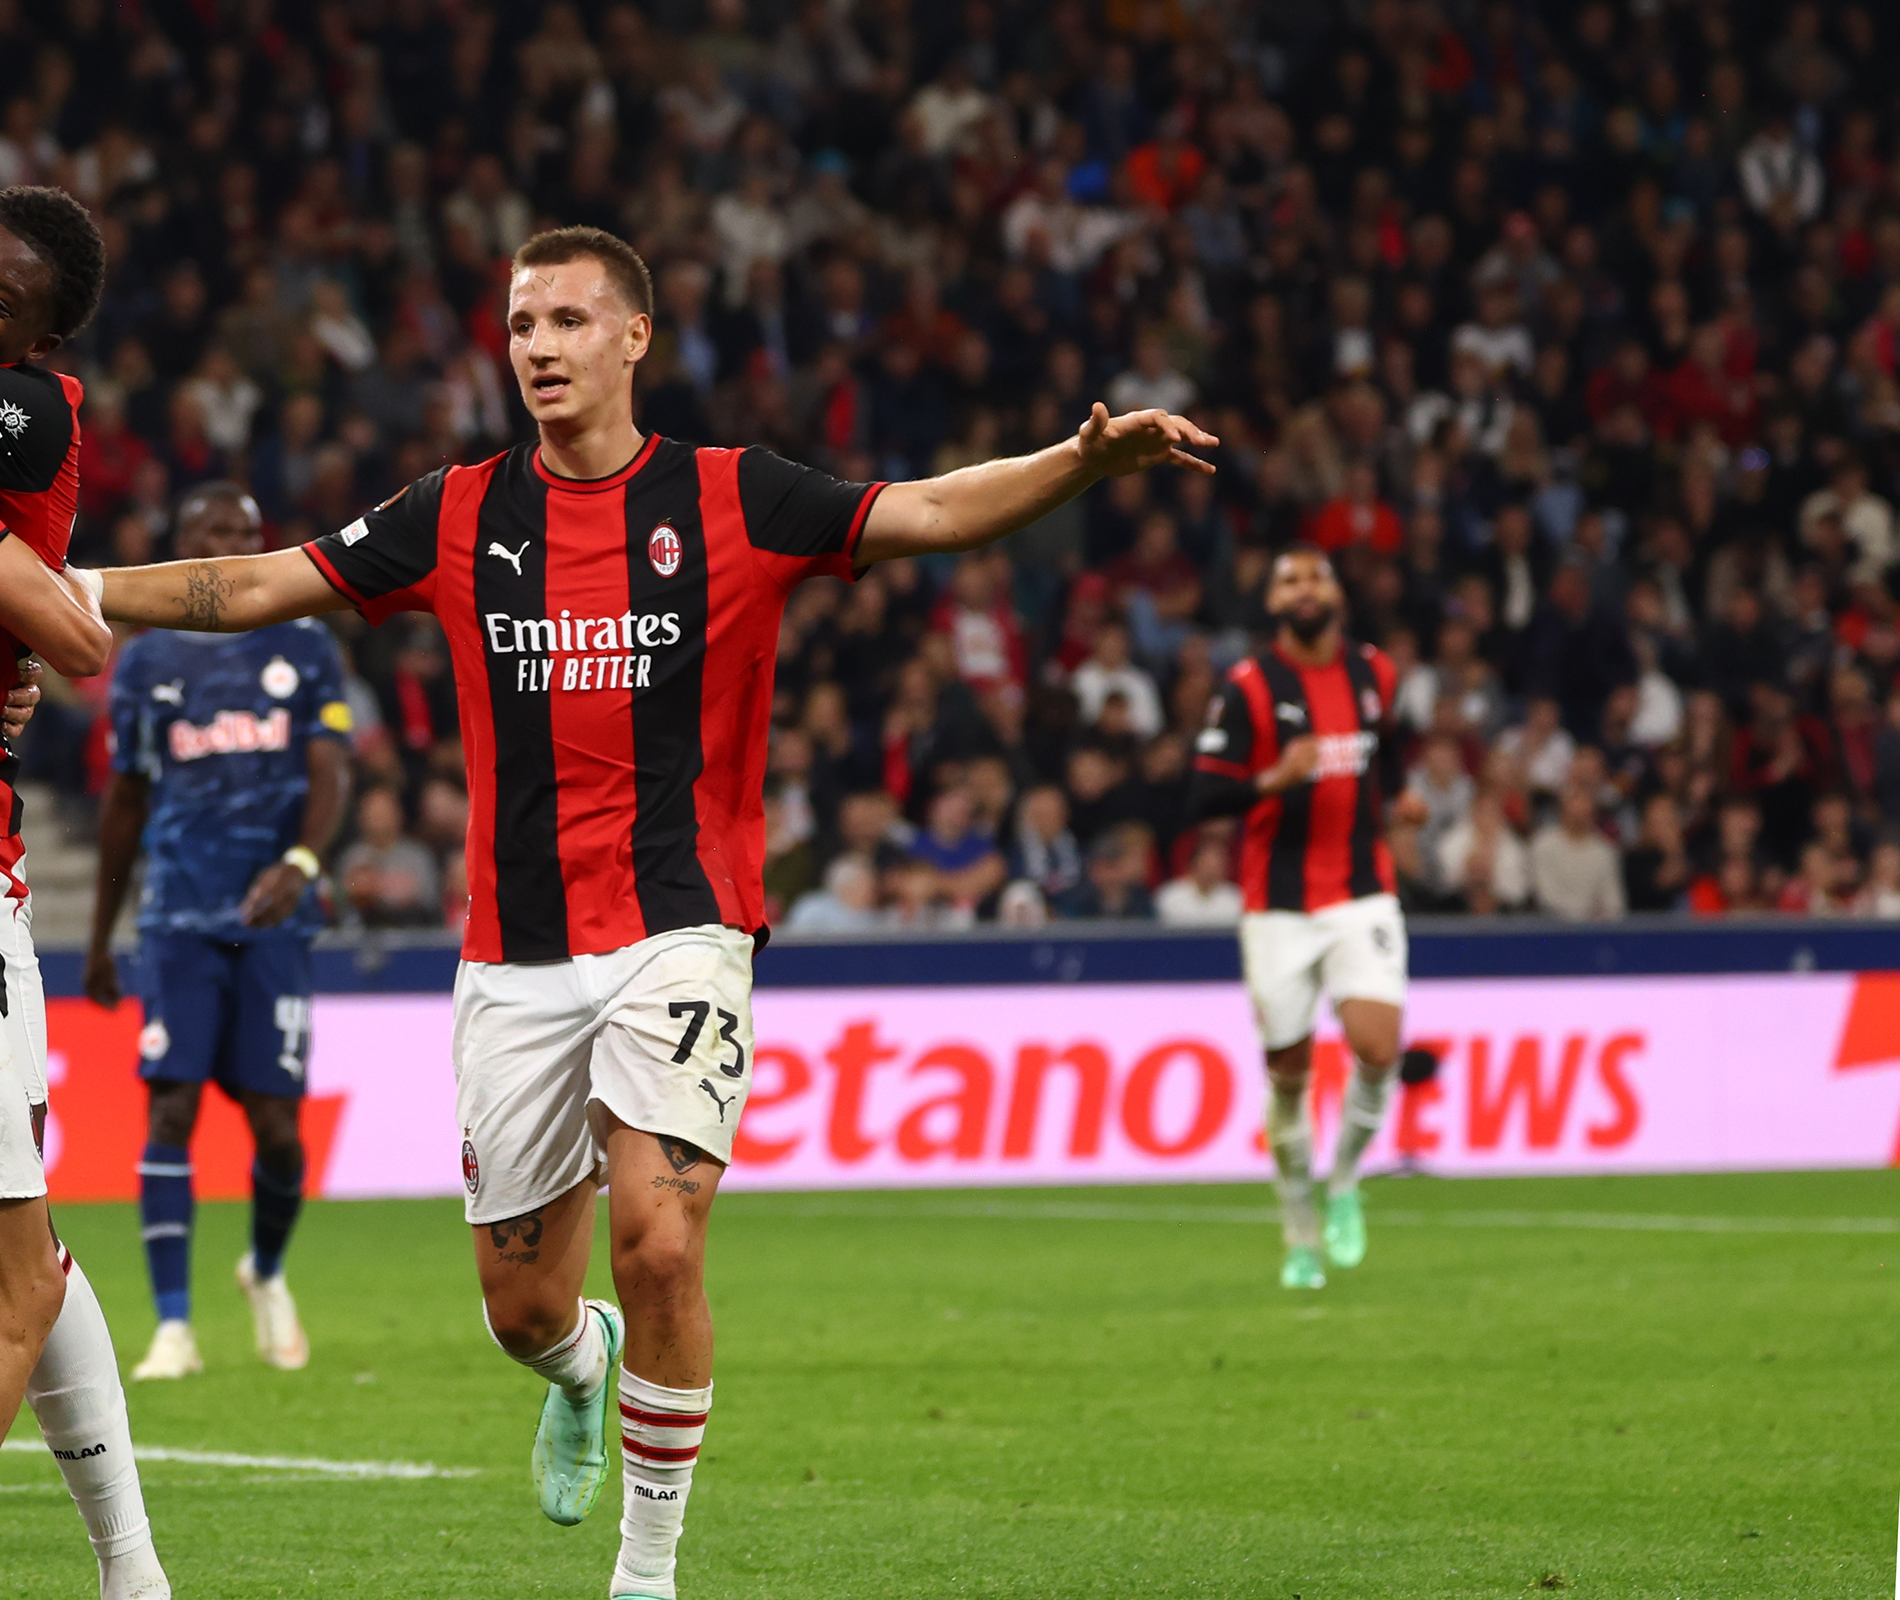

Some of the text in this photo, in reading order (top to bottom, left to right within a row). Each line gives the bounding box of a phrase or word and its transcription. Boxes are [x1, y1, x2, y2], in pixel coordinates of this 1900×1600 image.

[485, 609, 681, 653] Emirates
[518, 654, 652, 692] FLY BETTER
[668, 1000, 745, 1078] 73
[634, 1484, 678, 1501] MILAN
